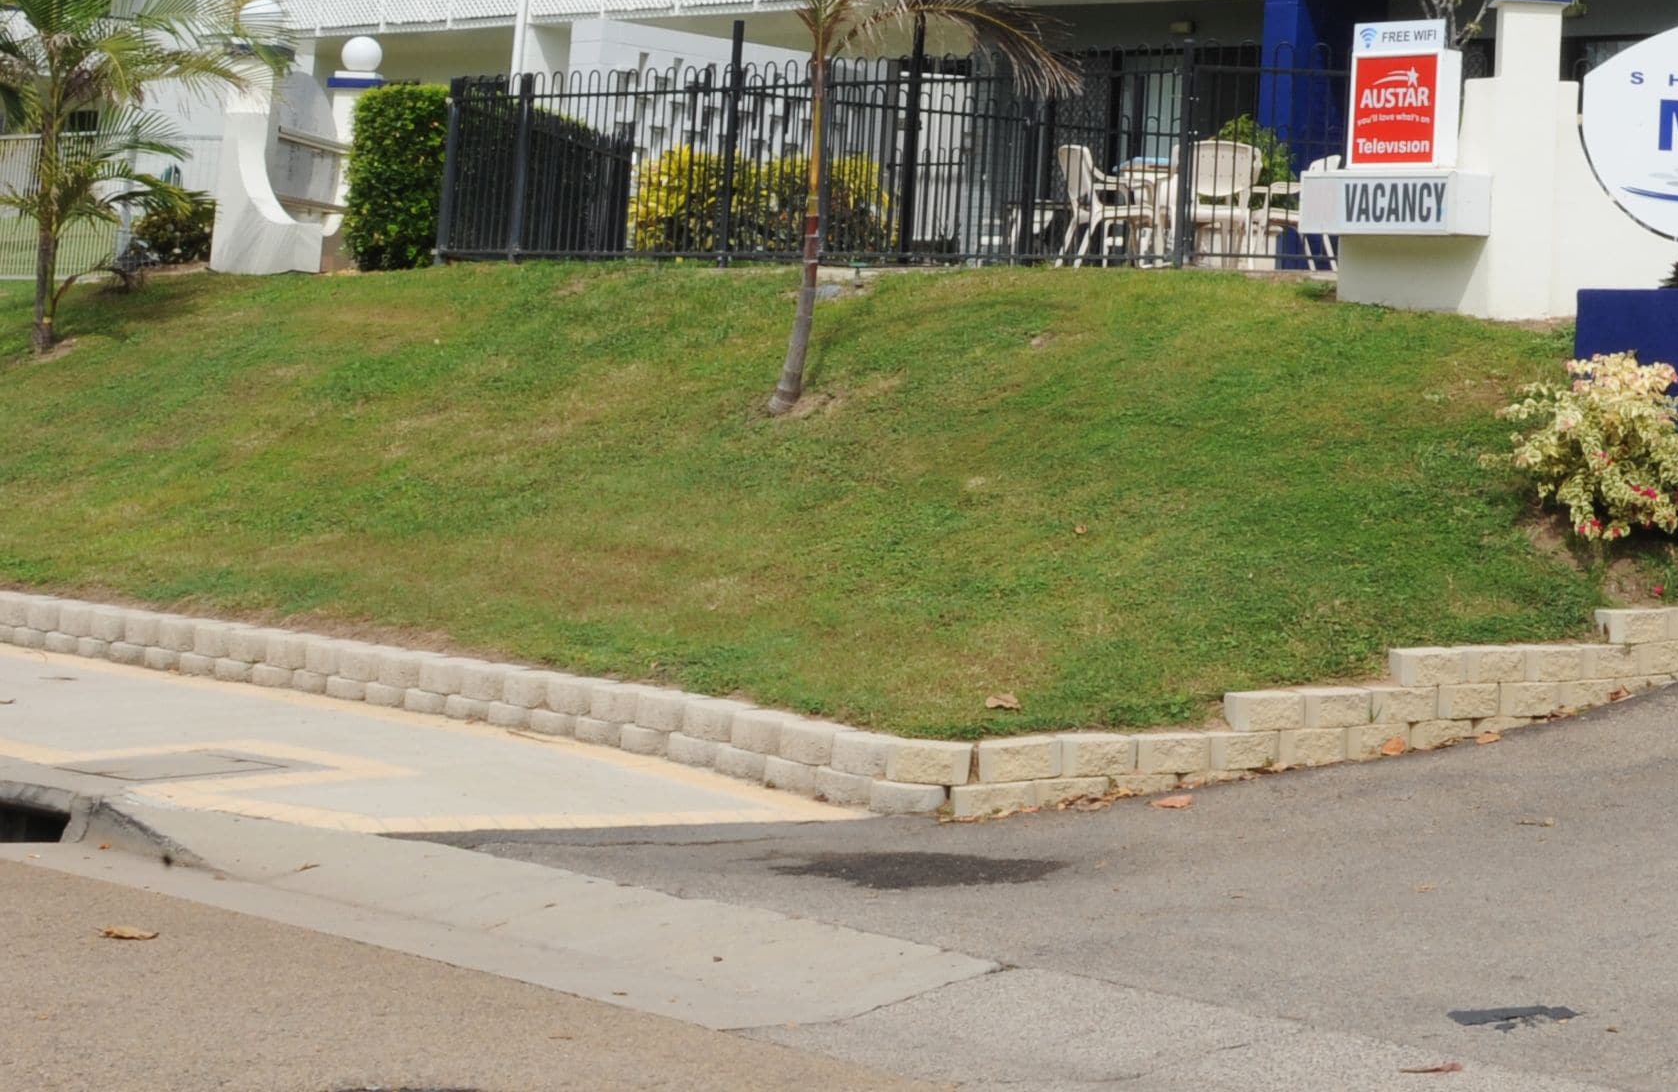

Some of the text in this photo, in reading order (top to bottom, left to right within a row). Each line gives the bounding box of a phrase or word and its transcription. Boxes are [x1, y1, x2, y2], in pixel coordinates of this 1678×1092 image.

[1382, 29, 1437, 43] FREE WIFI
[1360, 86, 1430, 109] AUSTAR
[1356, 137, 1430, 154] Television
[1344, 182, 1446, 223] VACANCY
